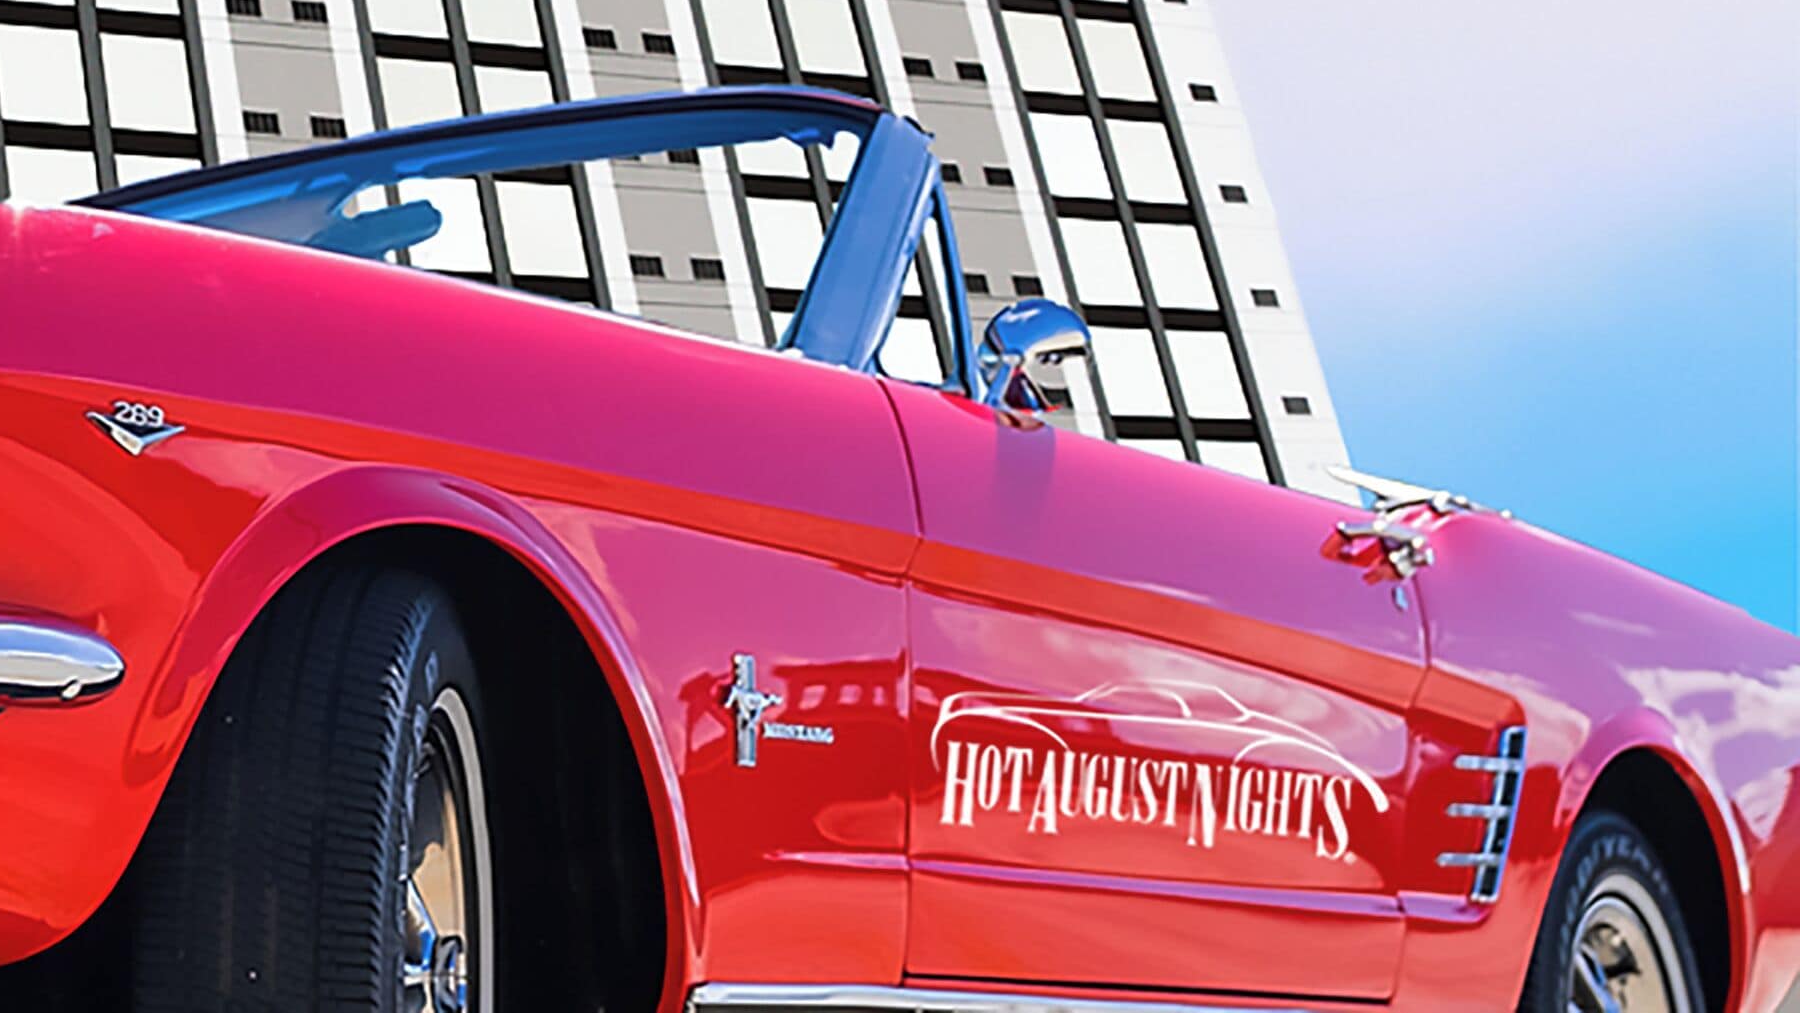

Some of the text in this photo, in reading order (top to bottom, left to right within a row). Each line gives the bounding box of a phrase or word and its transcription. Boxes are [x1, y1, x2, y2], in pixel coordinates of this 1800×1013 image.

[112, 400, 164, 427] 289
[939, 740, 1034, 827] HOT
[1026, 749, 1189, 835] AUGUST
